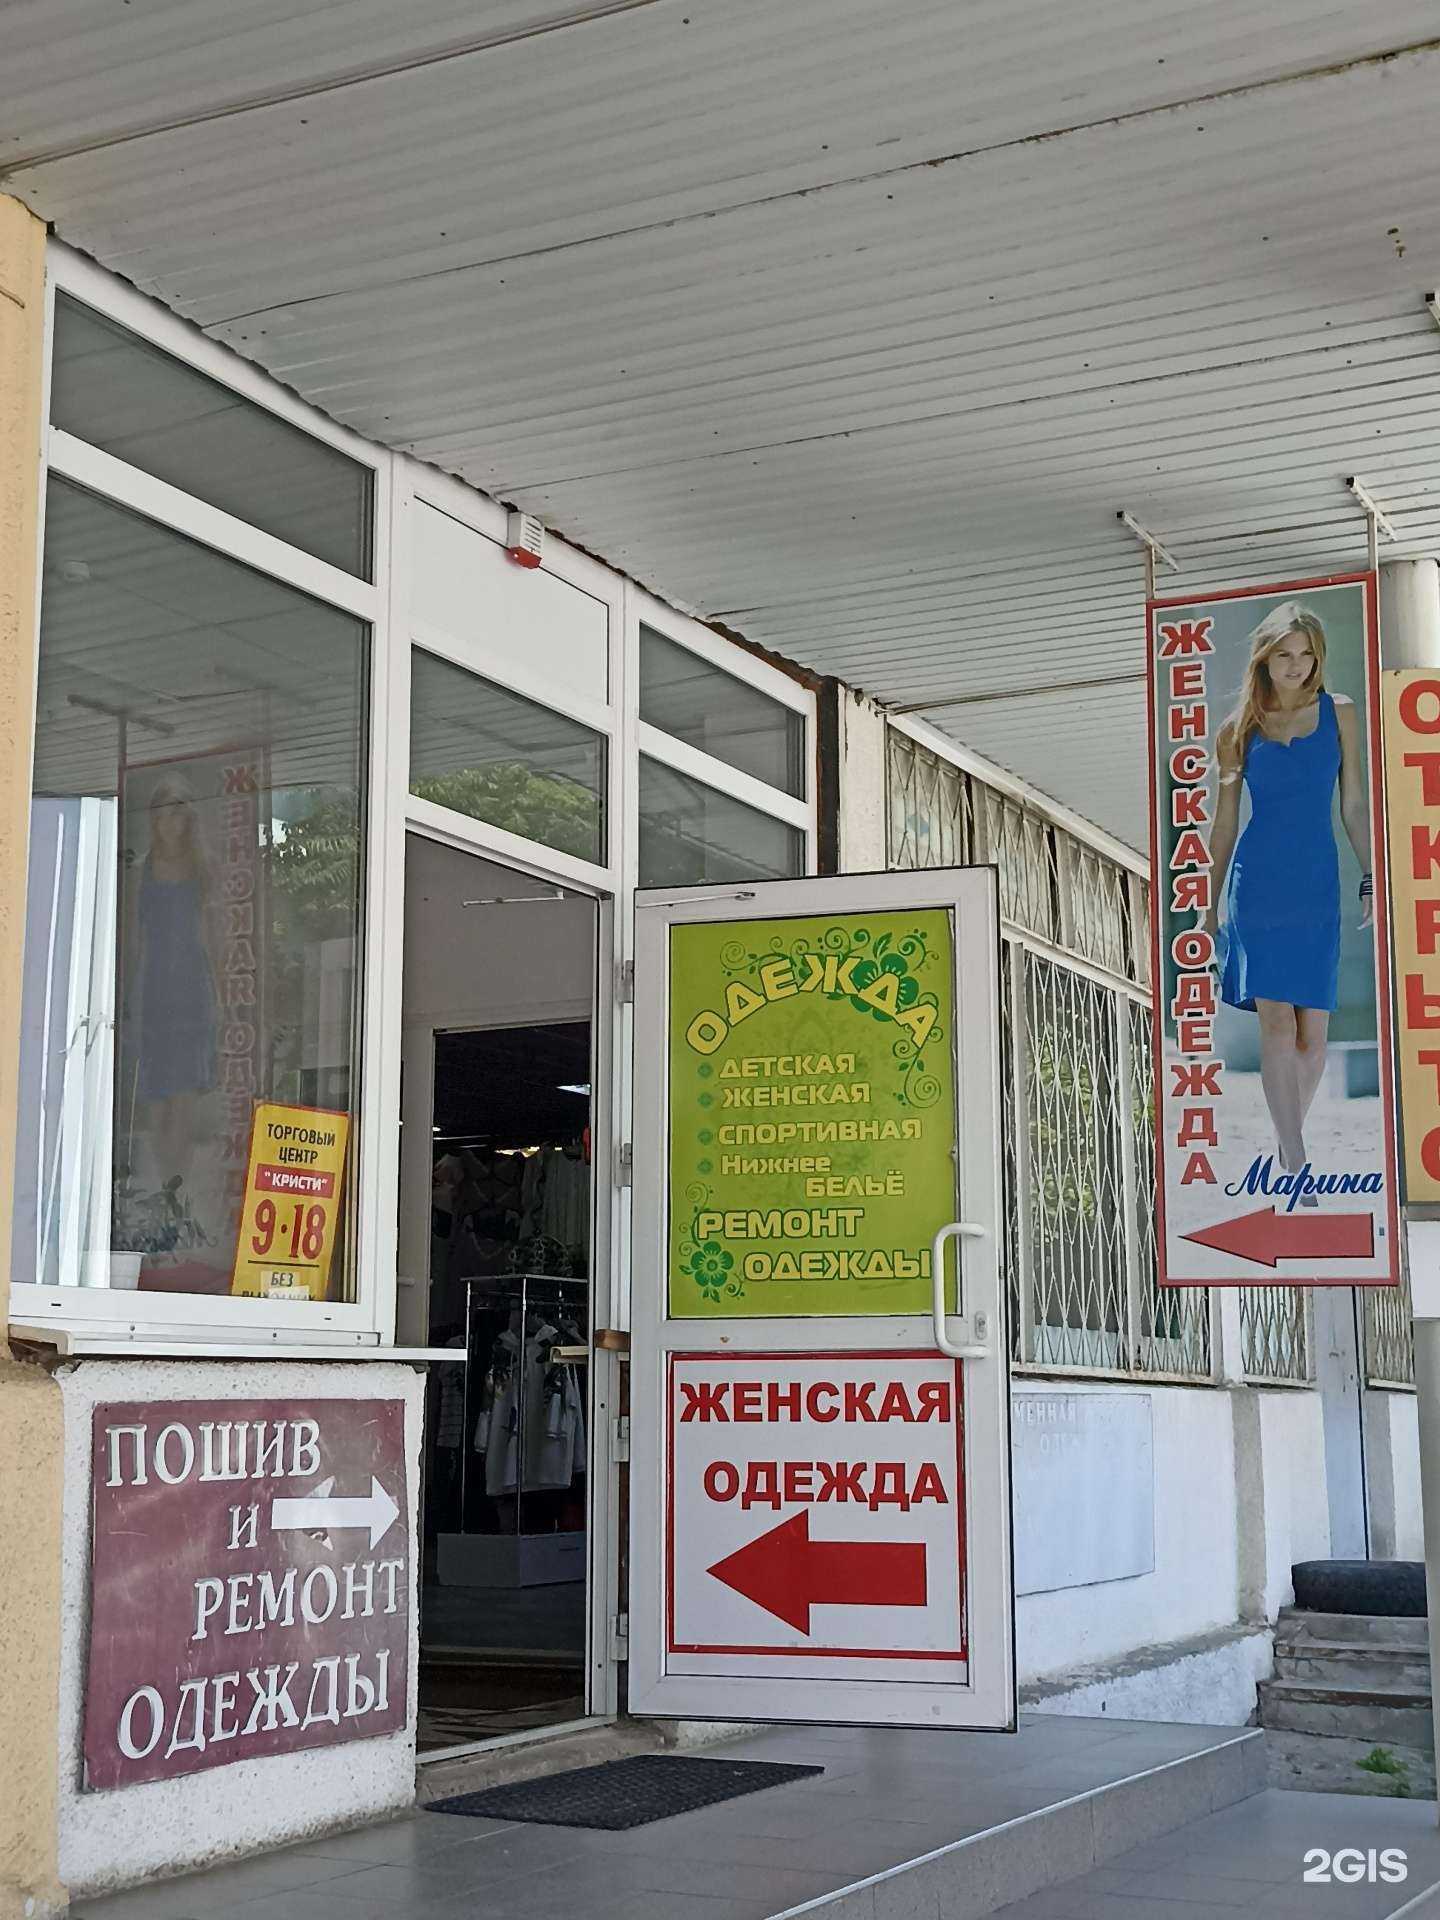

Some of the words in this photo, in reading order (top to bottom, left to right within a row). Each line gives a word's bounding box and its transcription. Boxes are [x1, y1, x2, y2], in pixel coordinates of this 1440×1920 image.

[1160, 616, 1213, 910] ЖЕНСКАЯ
[686, 953, 938, 1054] ОДЕЖДА
[719, 1053, 855, 1079] ДЕТСКАЯ
[1171, 932, 1223, 1185] ОДЕЖДА
[721, 1082, 870, 1108] ЖЕНСКАЯ
[267, 1123, 336, 1147] ТОРГОВЫЙ
[718, 1118, 922, 1146] СПОРТИВНАЯ
[279, 1146, 319, 1164] ЦЕНТР
[721, 1155, 831, 1175] Нижнее
[805, 1170, 904, 1198] БЕЛЬЁ
[1225, 1155, 1383, 1212] Марина
[697, 1208, 864, 1240] РЕМОНТ
[271, 1271, 294, 1287] БЕЗ
[743, 1251, 931, 1281] ОДЕЖДЫ
[680, 1382, 951, 1422] ЖЕНСКАЯ
[105, 1419, 321, 1487] ПОШИВ
[703, 1461, 949, 1512] ОДЕЖДА
[227, 1504, 260, 1549] И
[192, 1558, 404, 1640] РЕМОНТ
[117, 1648, 390, 1760] ОДЕЖДЫ
